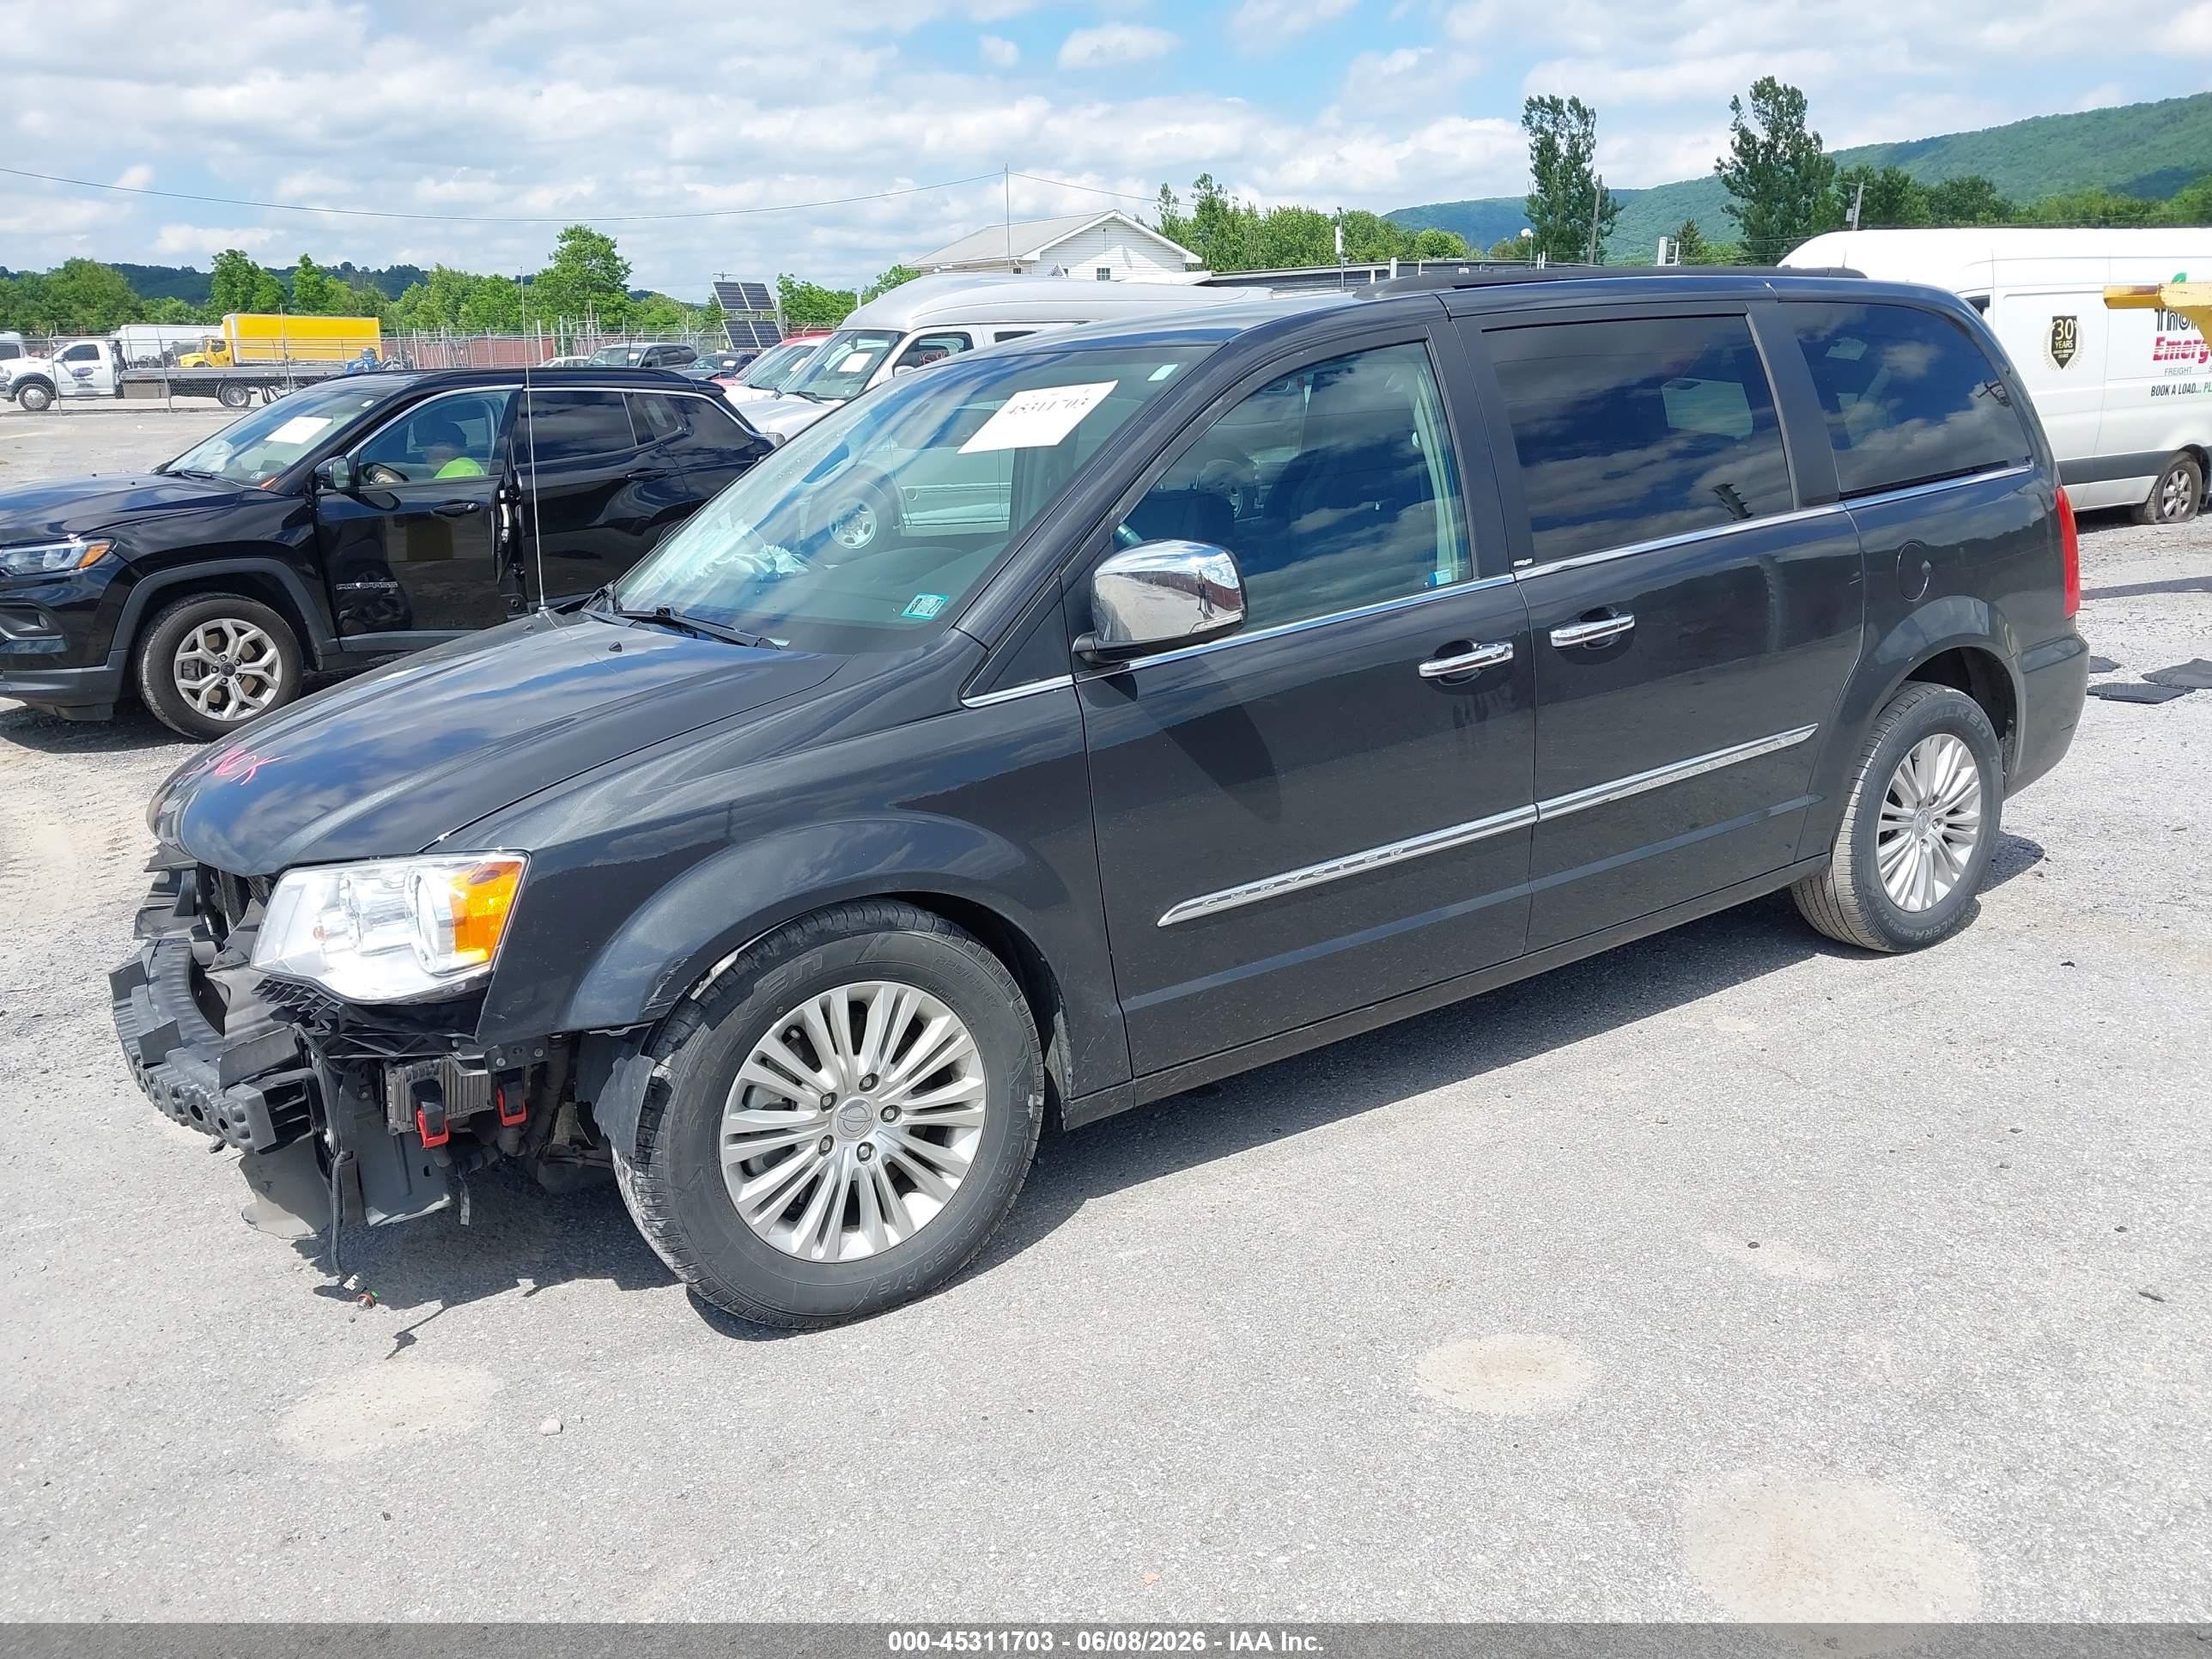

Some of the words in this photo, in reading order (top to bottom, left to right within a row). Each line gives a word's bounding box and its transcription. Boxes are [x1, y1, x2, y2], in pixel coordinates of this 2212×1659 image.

[2055, 318, 2074, 341] 30
[2055, 340, 2074, 349] YEARS
[2153, 336, 2212, 364] Emerg
[2164, 366, 2193, 377] FREIGHT
[2151, 384, 2170, 397] BOOK
[2171, 384, 2178, 396] A
[2178, 382, 2202, 395] LOAD...
